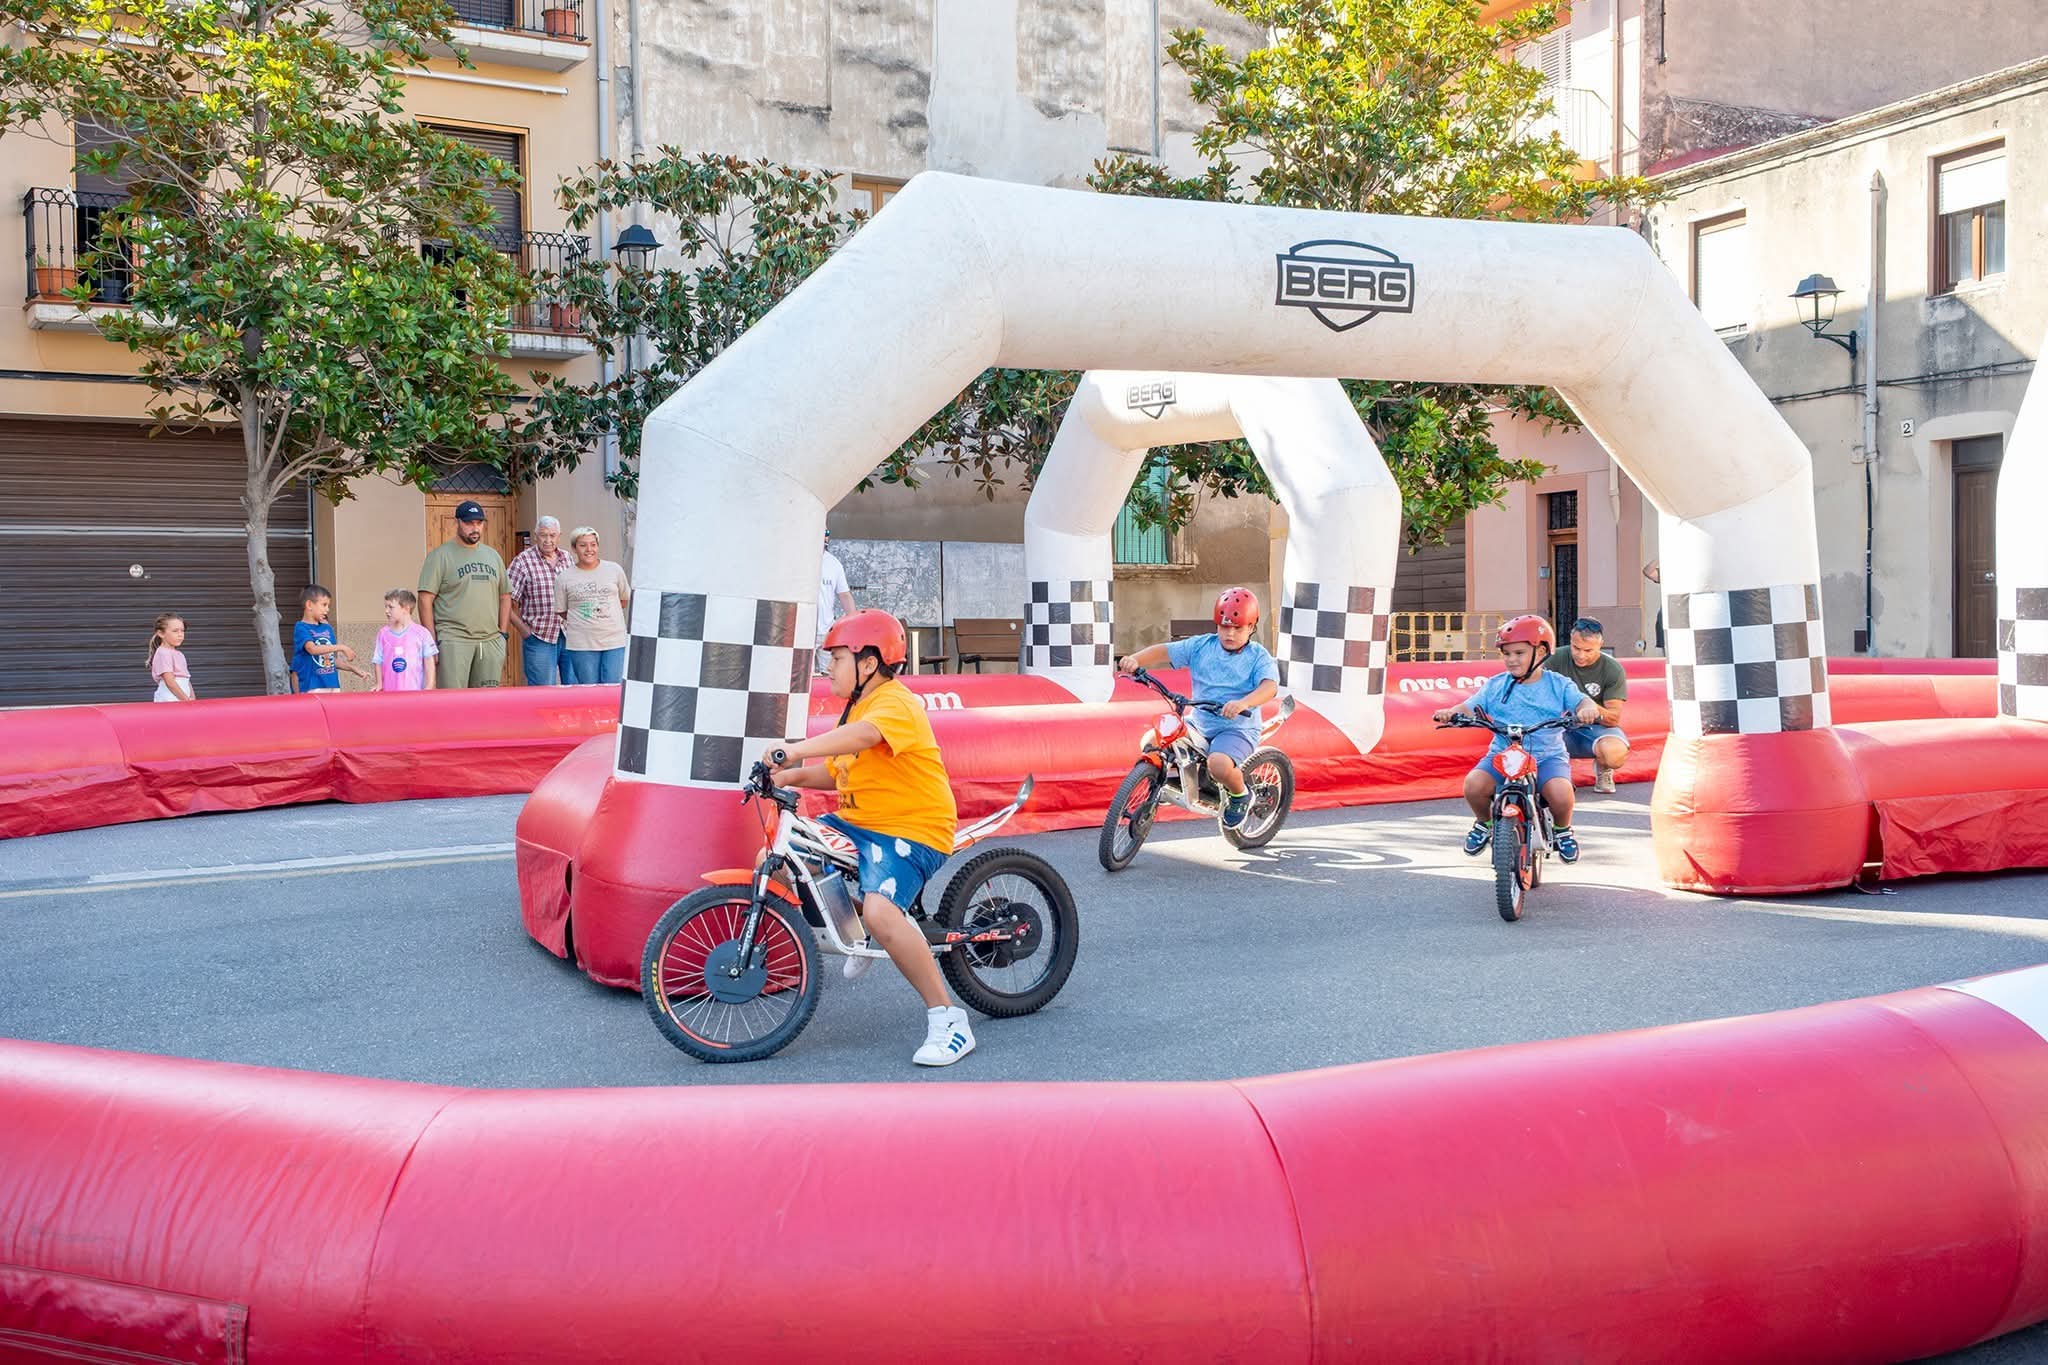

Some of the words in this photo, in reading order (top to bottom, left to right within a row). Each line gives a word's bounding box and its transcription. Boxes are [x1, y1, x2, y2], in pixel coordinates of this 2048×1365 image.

[1285, 263, 1407, 302] BERG
[1130, 381, 1173, 403] BERG
[1903, 422, 1911, 434] 2
[457, 562, 498, 578] BOSTON
